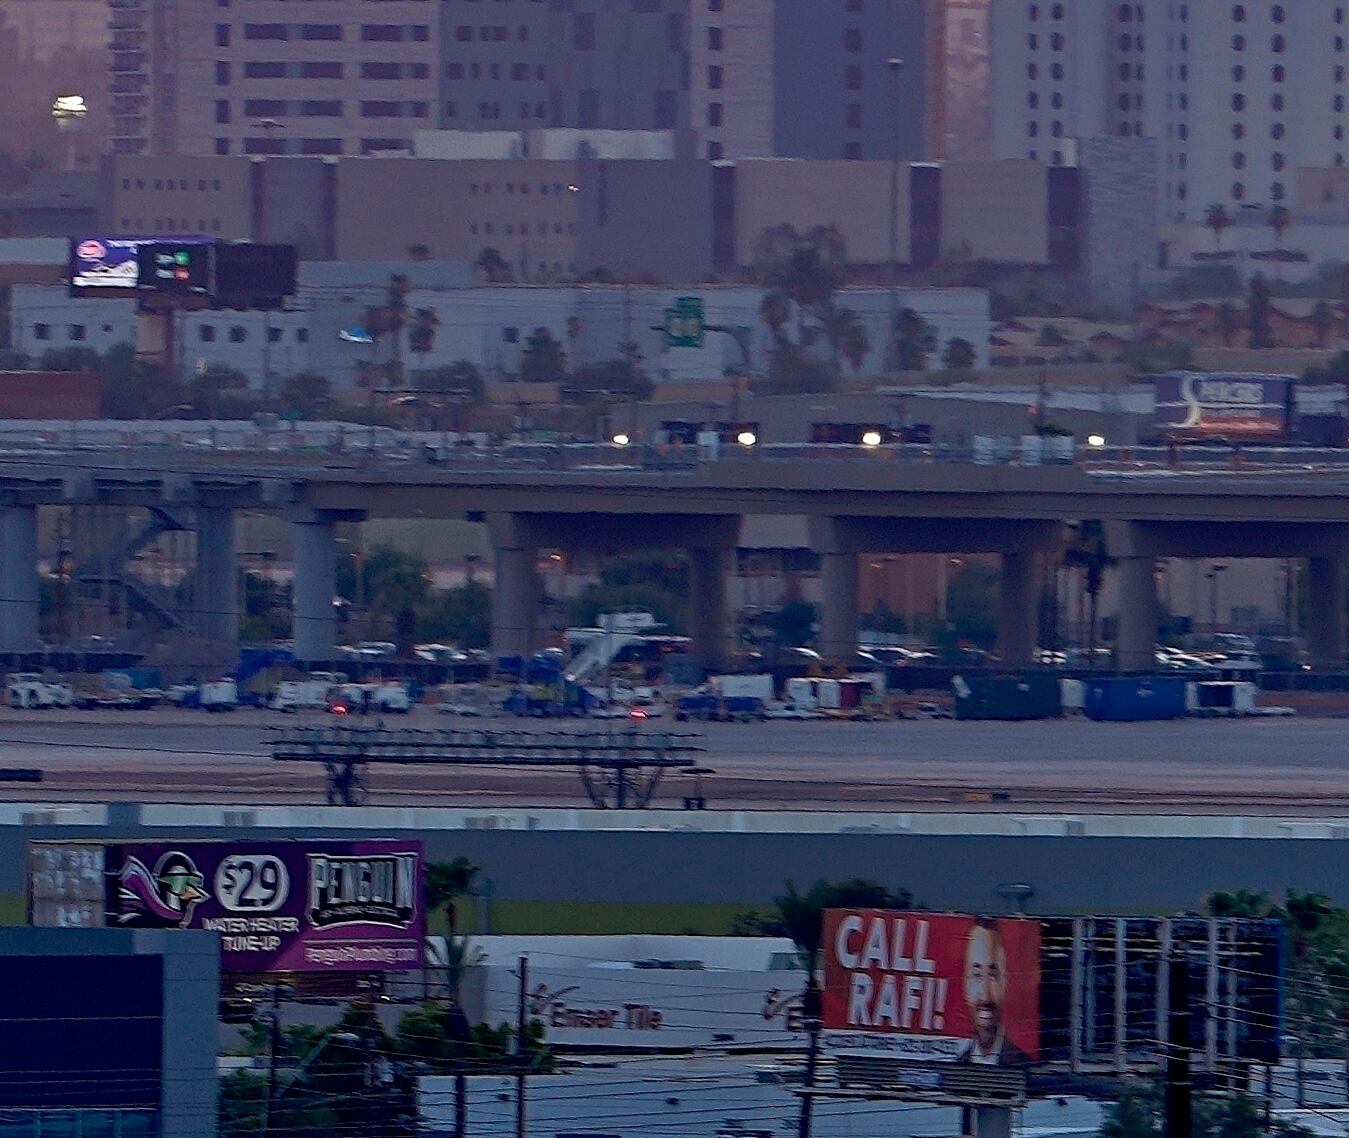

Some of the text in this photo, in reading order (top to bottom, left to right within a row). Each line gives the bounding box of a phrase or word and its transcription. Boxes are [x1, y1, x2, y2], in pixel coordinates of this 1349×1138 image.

[221, 860, 280, 907] $29
[312, 855, 416, 911] PENGUIN
[202, 917, 300, 933] WATER HEATER
[835, 915, 936, 974] CALL
[624, 1002, 663, 1029] Tile
[847, 971, 949, 1031] RAFI!
